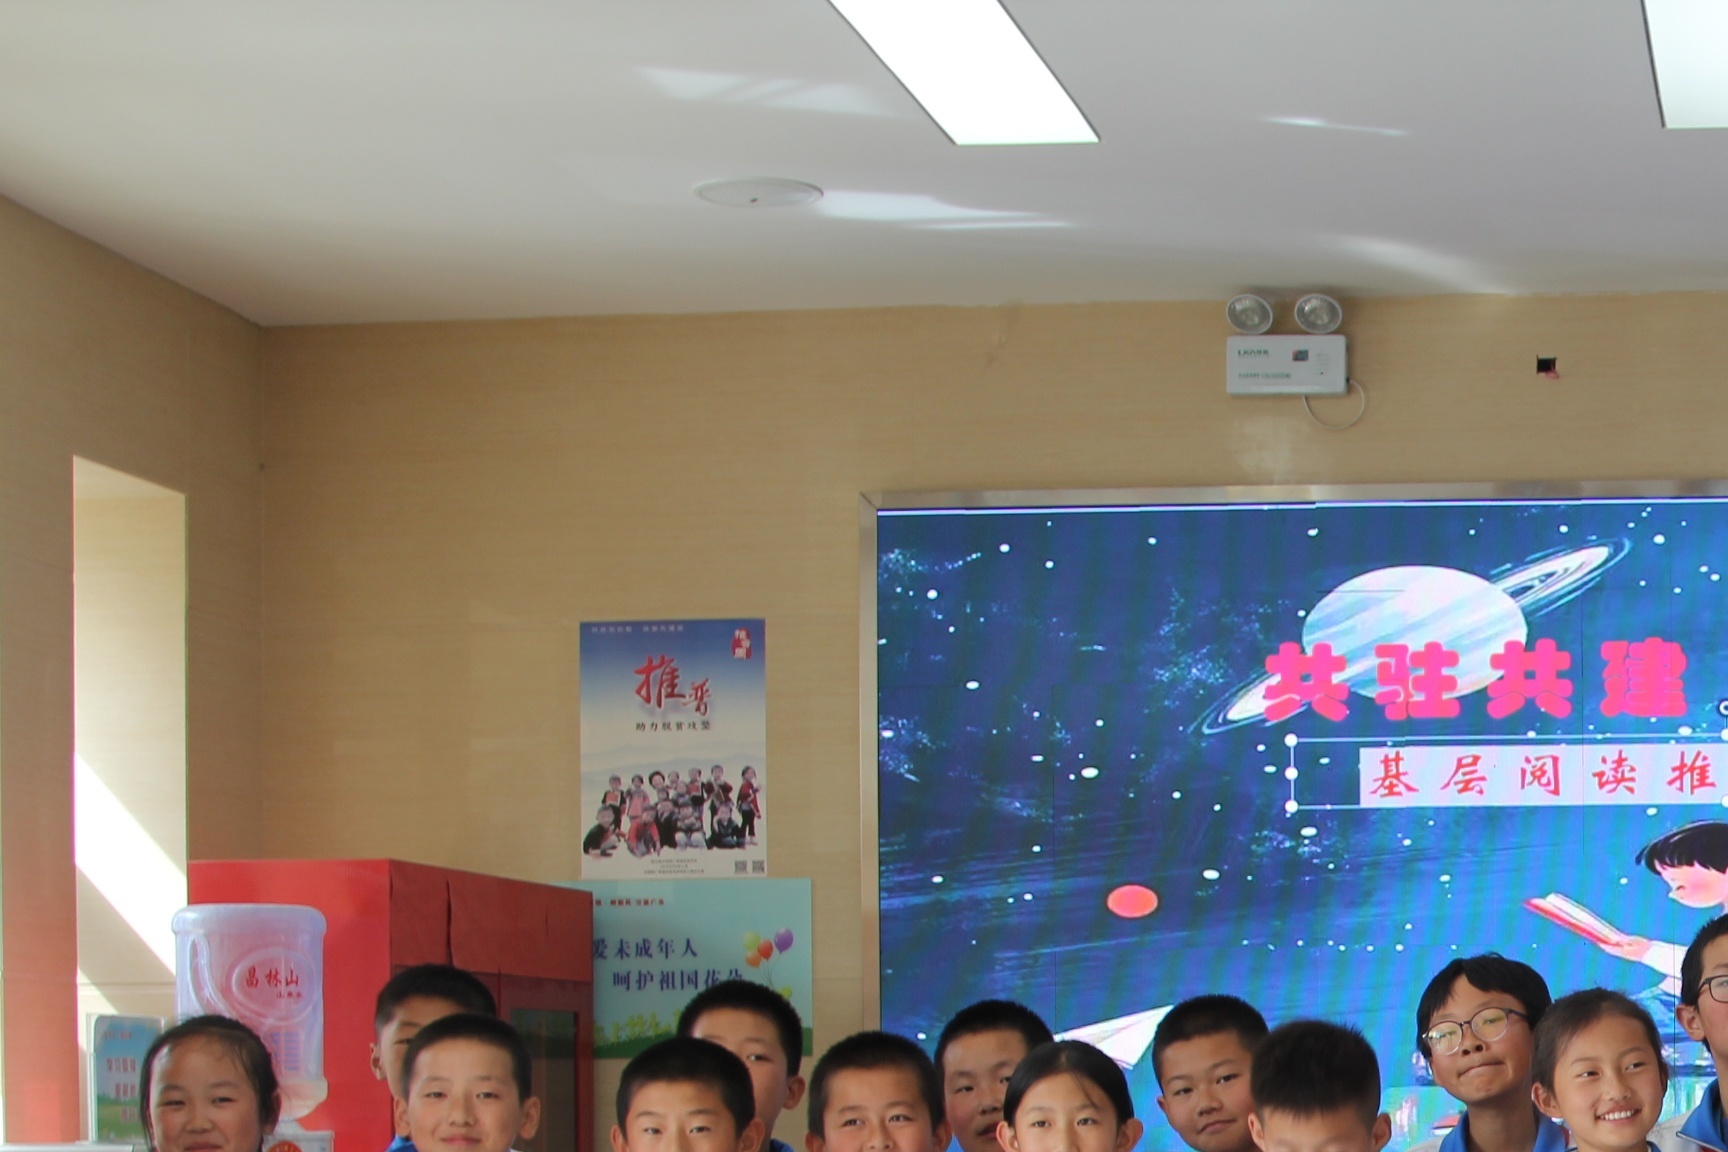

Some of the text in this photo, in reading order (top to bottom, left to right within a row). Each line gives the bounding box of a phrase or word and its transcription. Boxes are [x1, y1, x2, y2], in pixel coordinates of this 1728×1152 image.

[634, 654, 711, 716] 推普
[1264, 640, 1688, 721] 共驻共建
